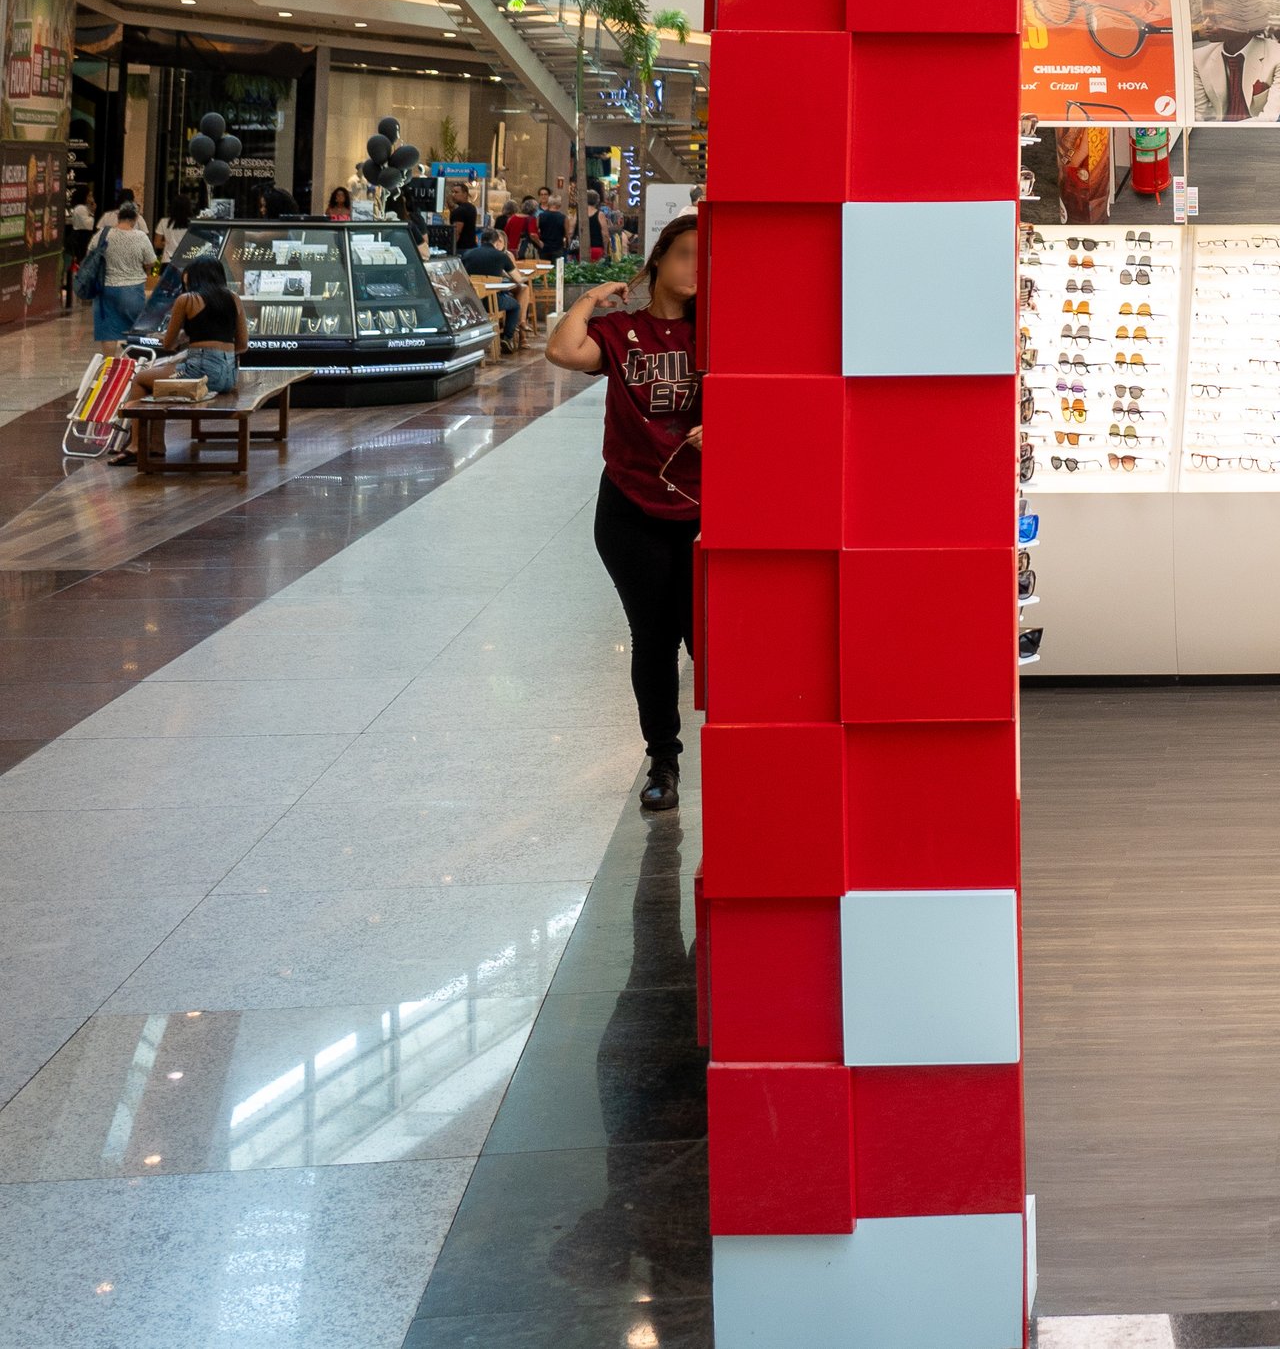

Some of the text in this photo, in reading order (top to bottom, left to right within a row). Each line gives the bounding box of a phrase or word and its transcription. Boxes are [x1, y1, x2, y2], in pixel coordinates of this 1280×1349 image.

[1050, 82, 1079, 91] Crizal
[1117, 82, 1149, 91] HOYA
[268, 341, 280, 349] EM
[281, 341, 298, 350] AÇO
[622, 348, 698, 386] CHIL
[650, 382, 698, 412] 97
